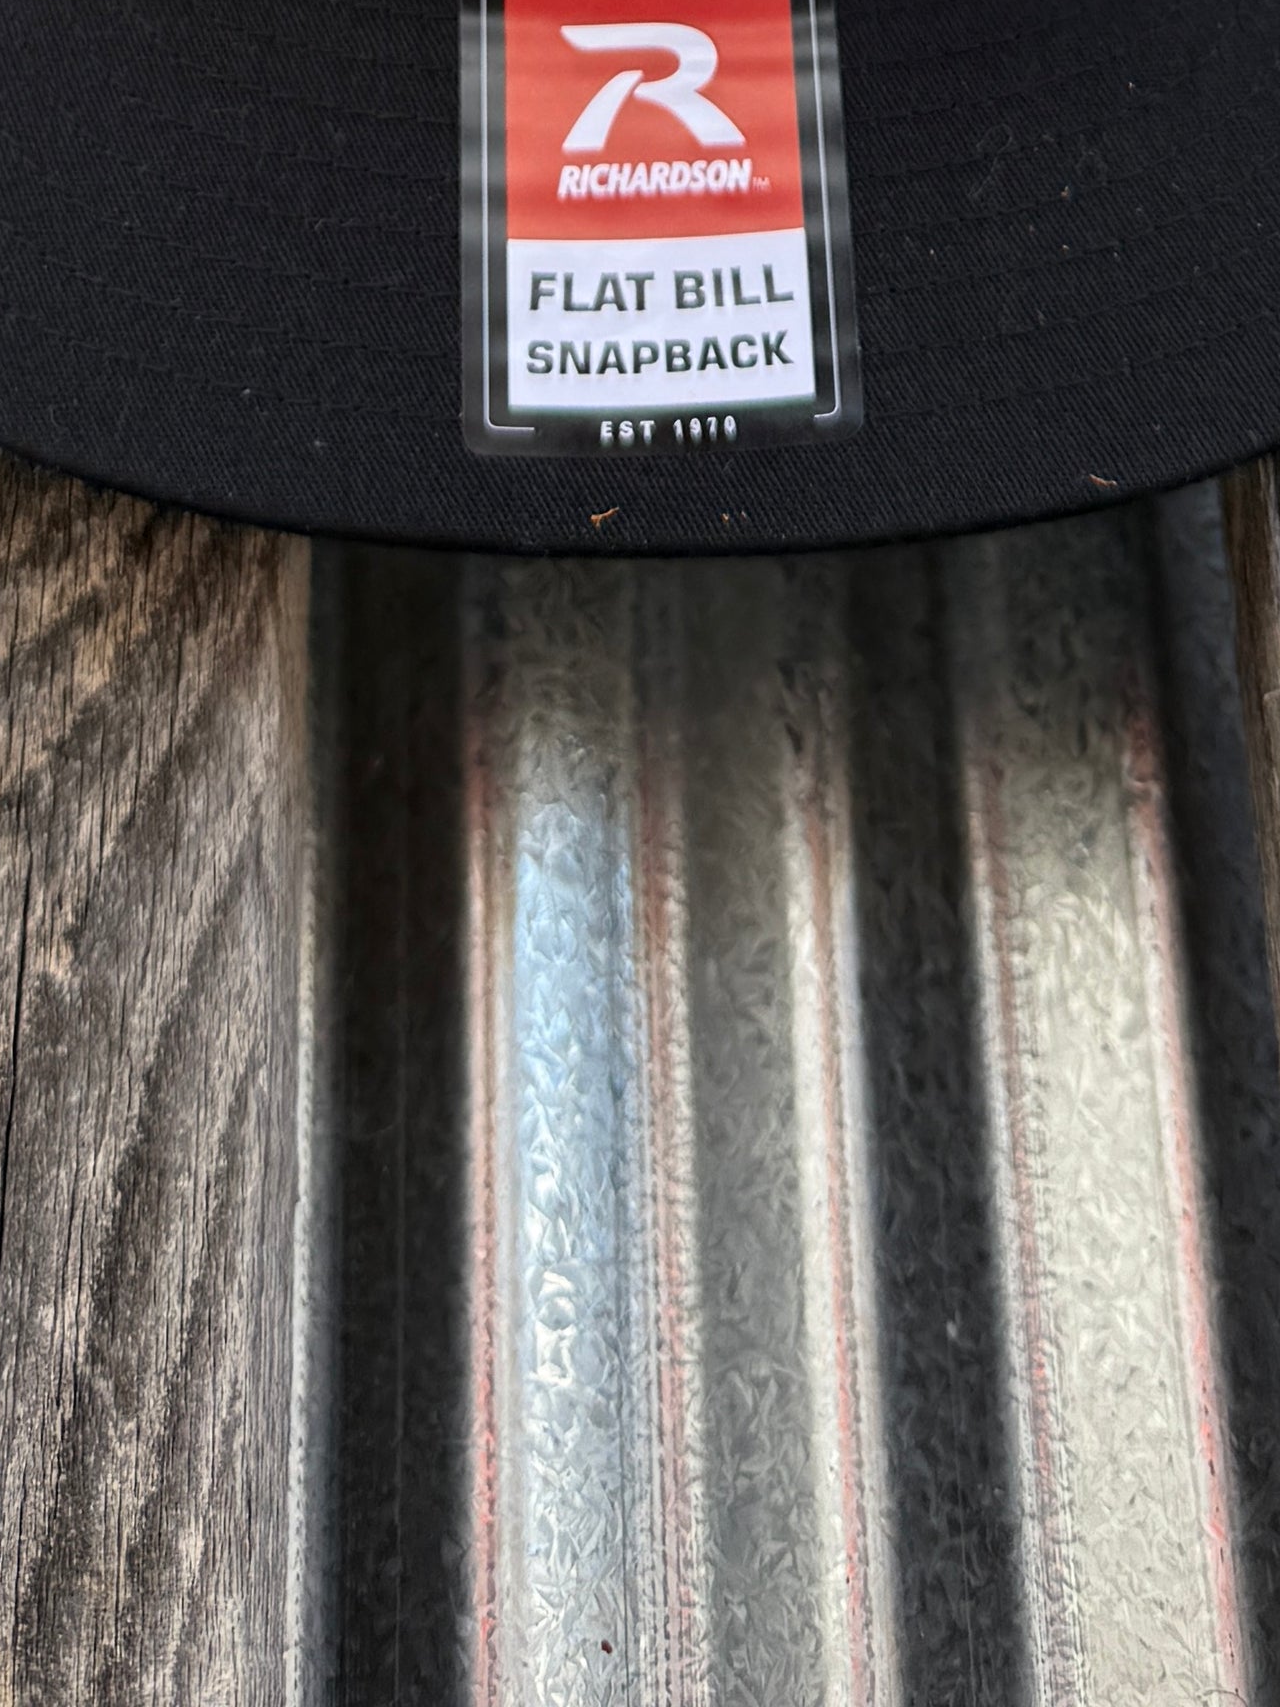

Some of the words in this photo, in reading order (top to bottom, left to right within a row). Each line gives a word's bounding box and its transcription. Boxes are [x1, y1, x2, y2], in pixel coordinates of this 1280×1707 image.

[557, 158, 753, 200] RICHARDSON
[529, 271, 655, 312] FLAT
[673, 263, 794, 310] BILL
[526, 329, 794, 376] SNAPBACK
[600, 419, 656, 448] EST
[672, 414, 738, 446] 1970
